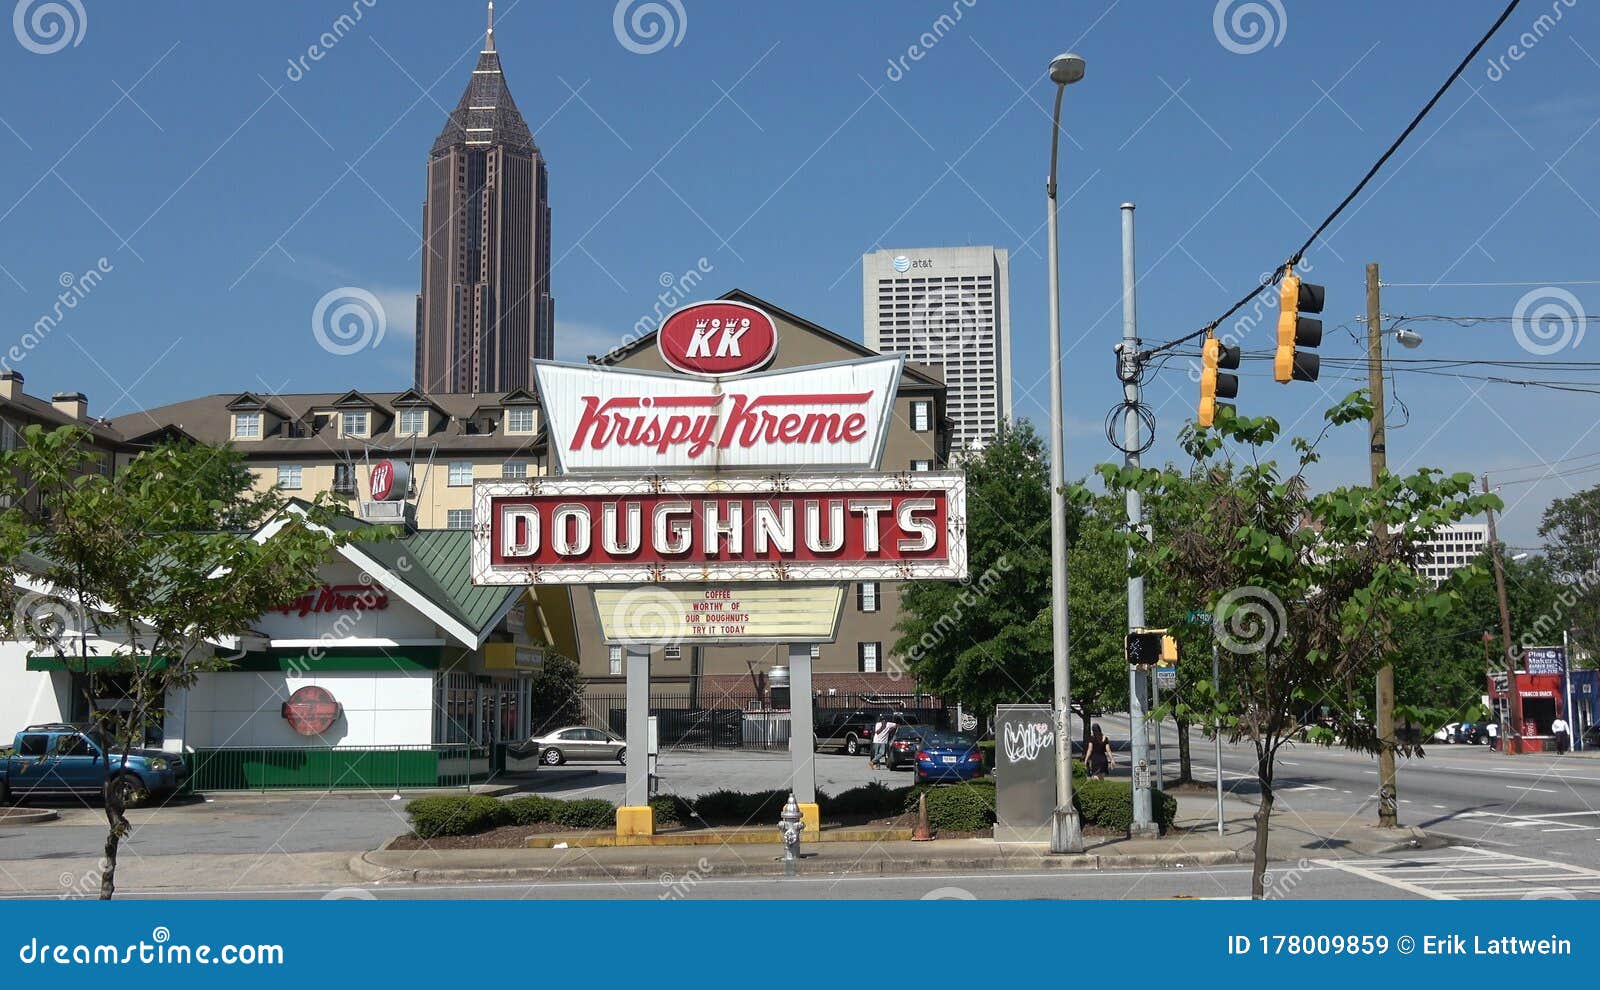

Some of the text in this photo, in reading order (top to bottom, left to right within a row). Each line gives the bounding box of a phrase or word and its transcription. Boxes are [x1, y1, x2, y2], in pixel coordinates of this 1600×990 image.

[912, 259, 932, 268] at&t
[686, 318, 750, 358] KK
[569, 390, 874, 459] Krispy Kreme
[500, 498, 937, 558] DOUGHNUTS
[705, 591, 731, 599] COFFEE
[693, 602, 740, 611] WORTHY OF
[685, 614, 749, 623] OUR DOUGHNUTS
[693, 625, 745, 634] TRY IT TODAY
